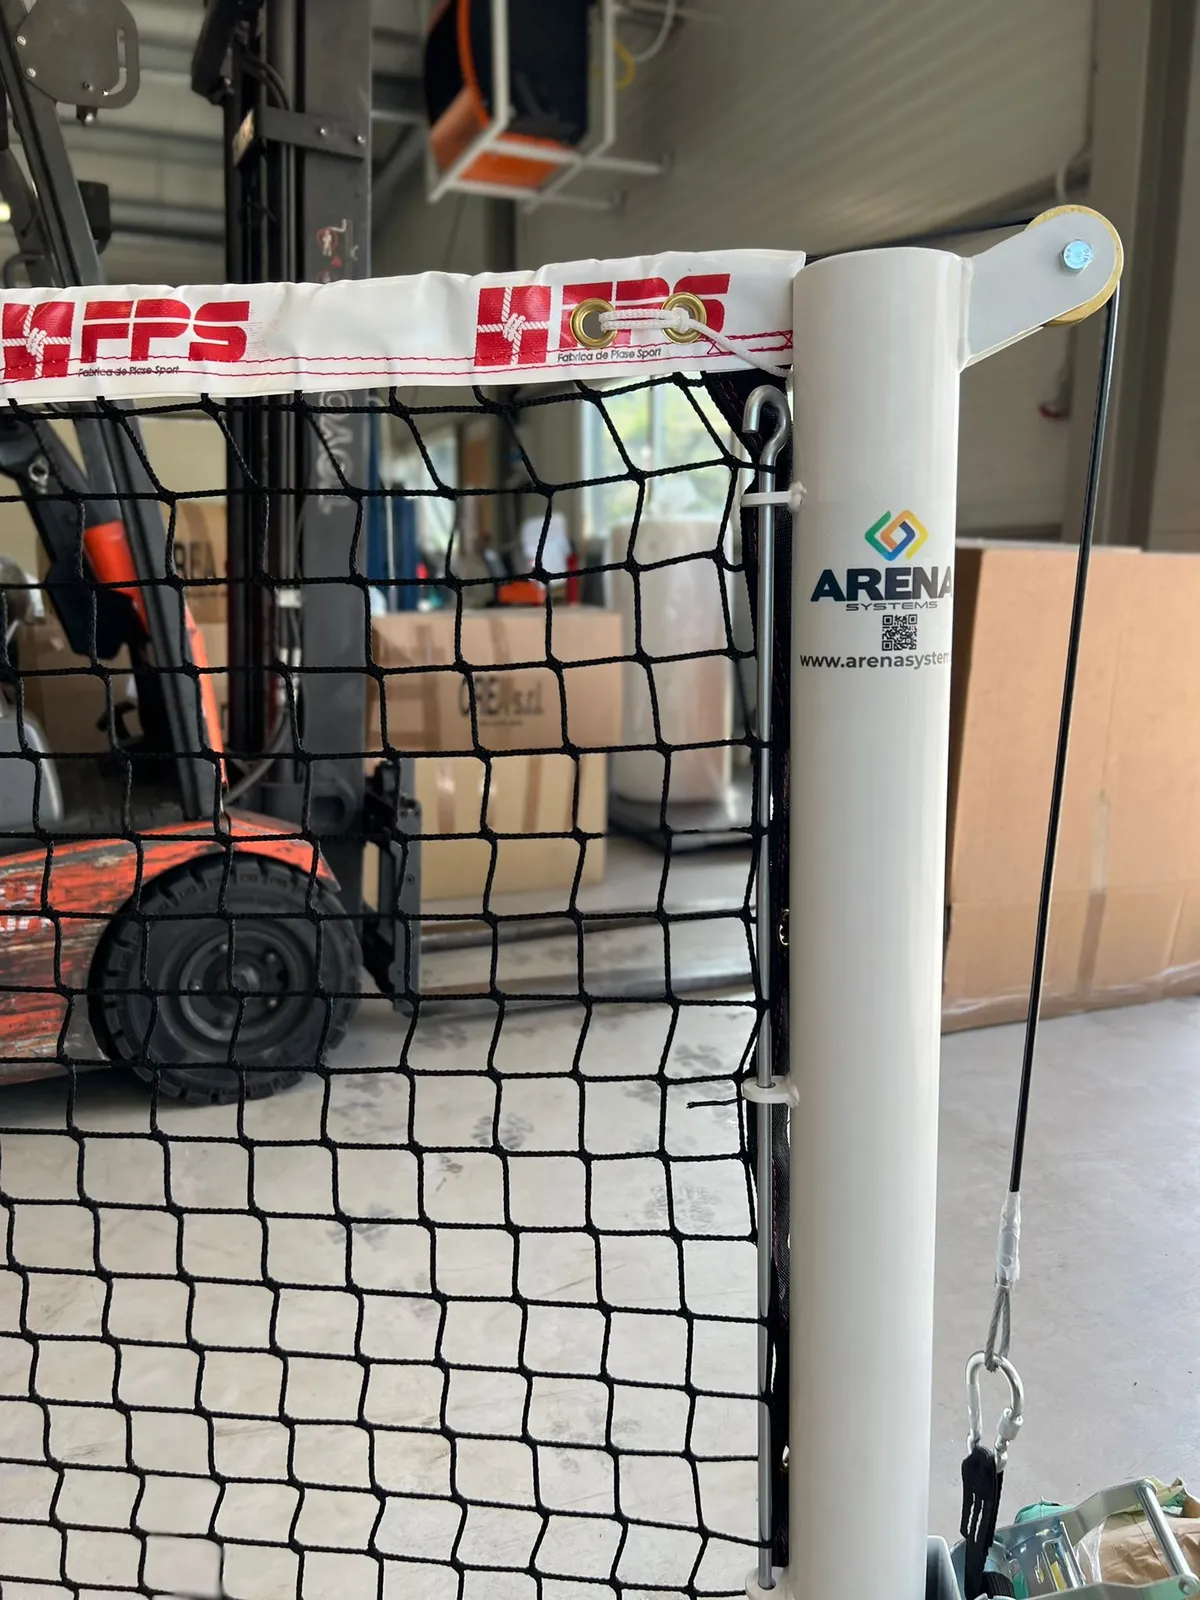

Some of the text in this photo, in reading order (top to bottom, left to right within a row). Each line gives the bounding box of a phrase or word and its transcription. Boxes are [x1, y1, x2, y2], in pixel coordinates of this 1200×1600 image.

[557, 352, 593, 363] Fabrica
[596, 351, 608, 360] de
[637, 348, 662, 359] Sport
[78, 367, 112, 378] Fabrica
[155, 365, 180, 376] Sport
[810, 566, 953, 602] ARENA
[845, 601, 938, 611] SYSTEMS
[800, 651, 951, 669] www.arenasystem
